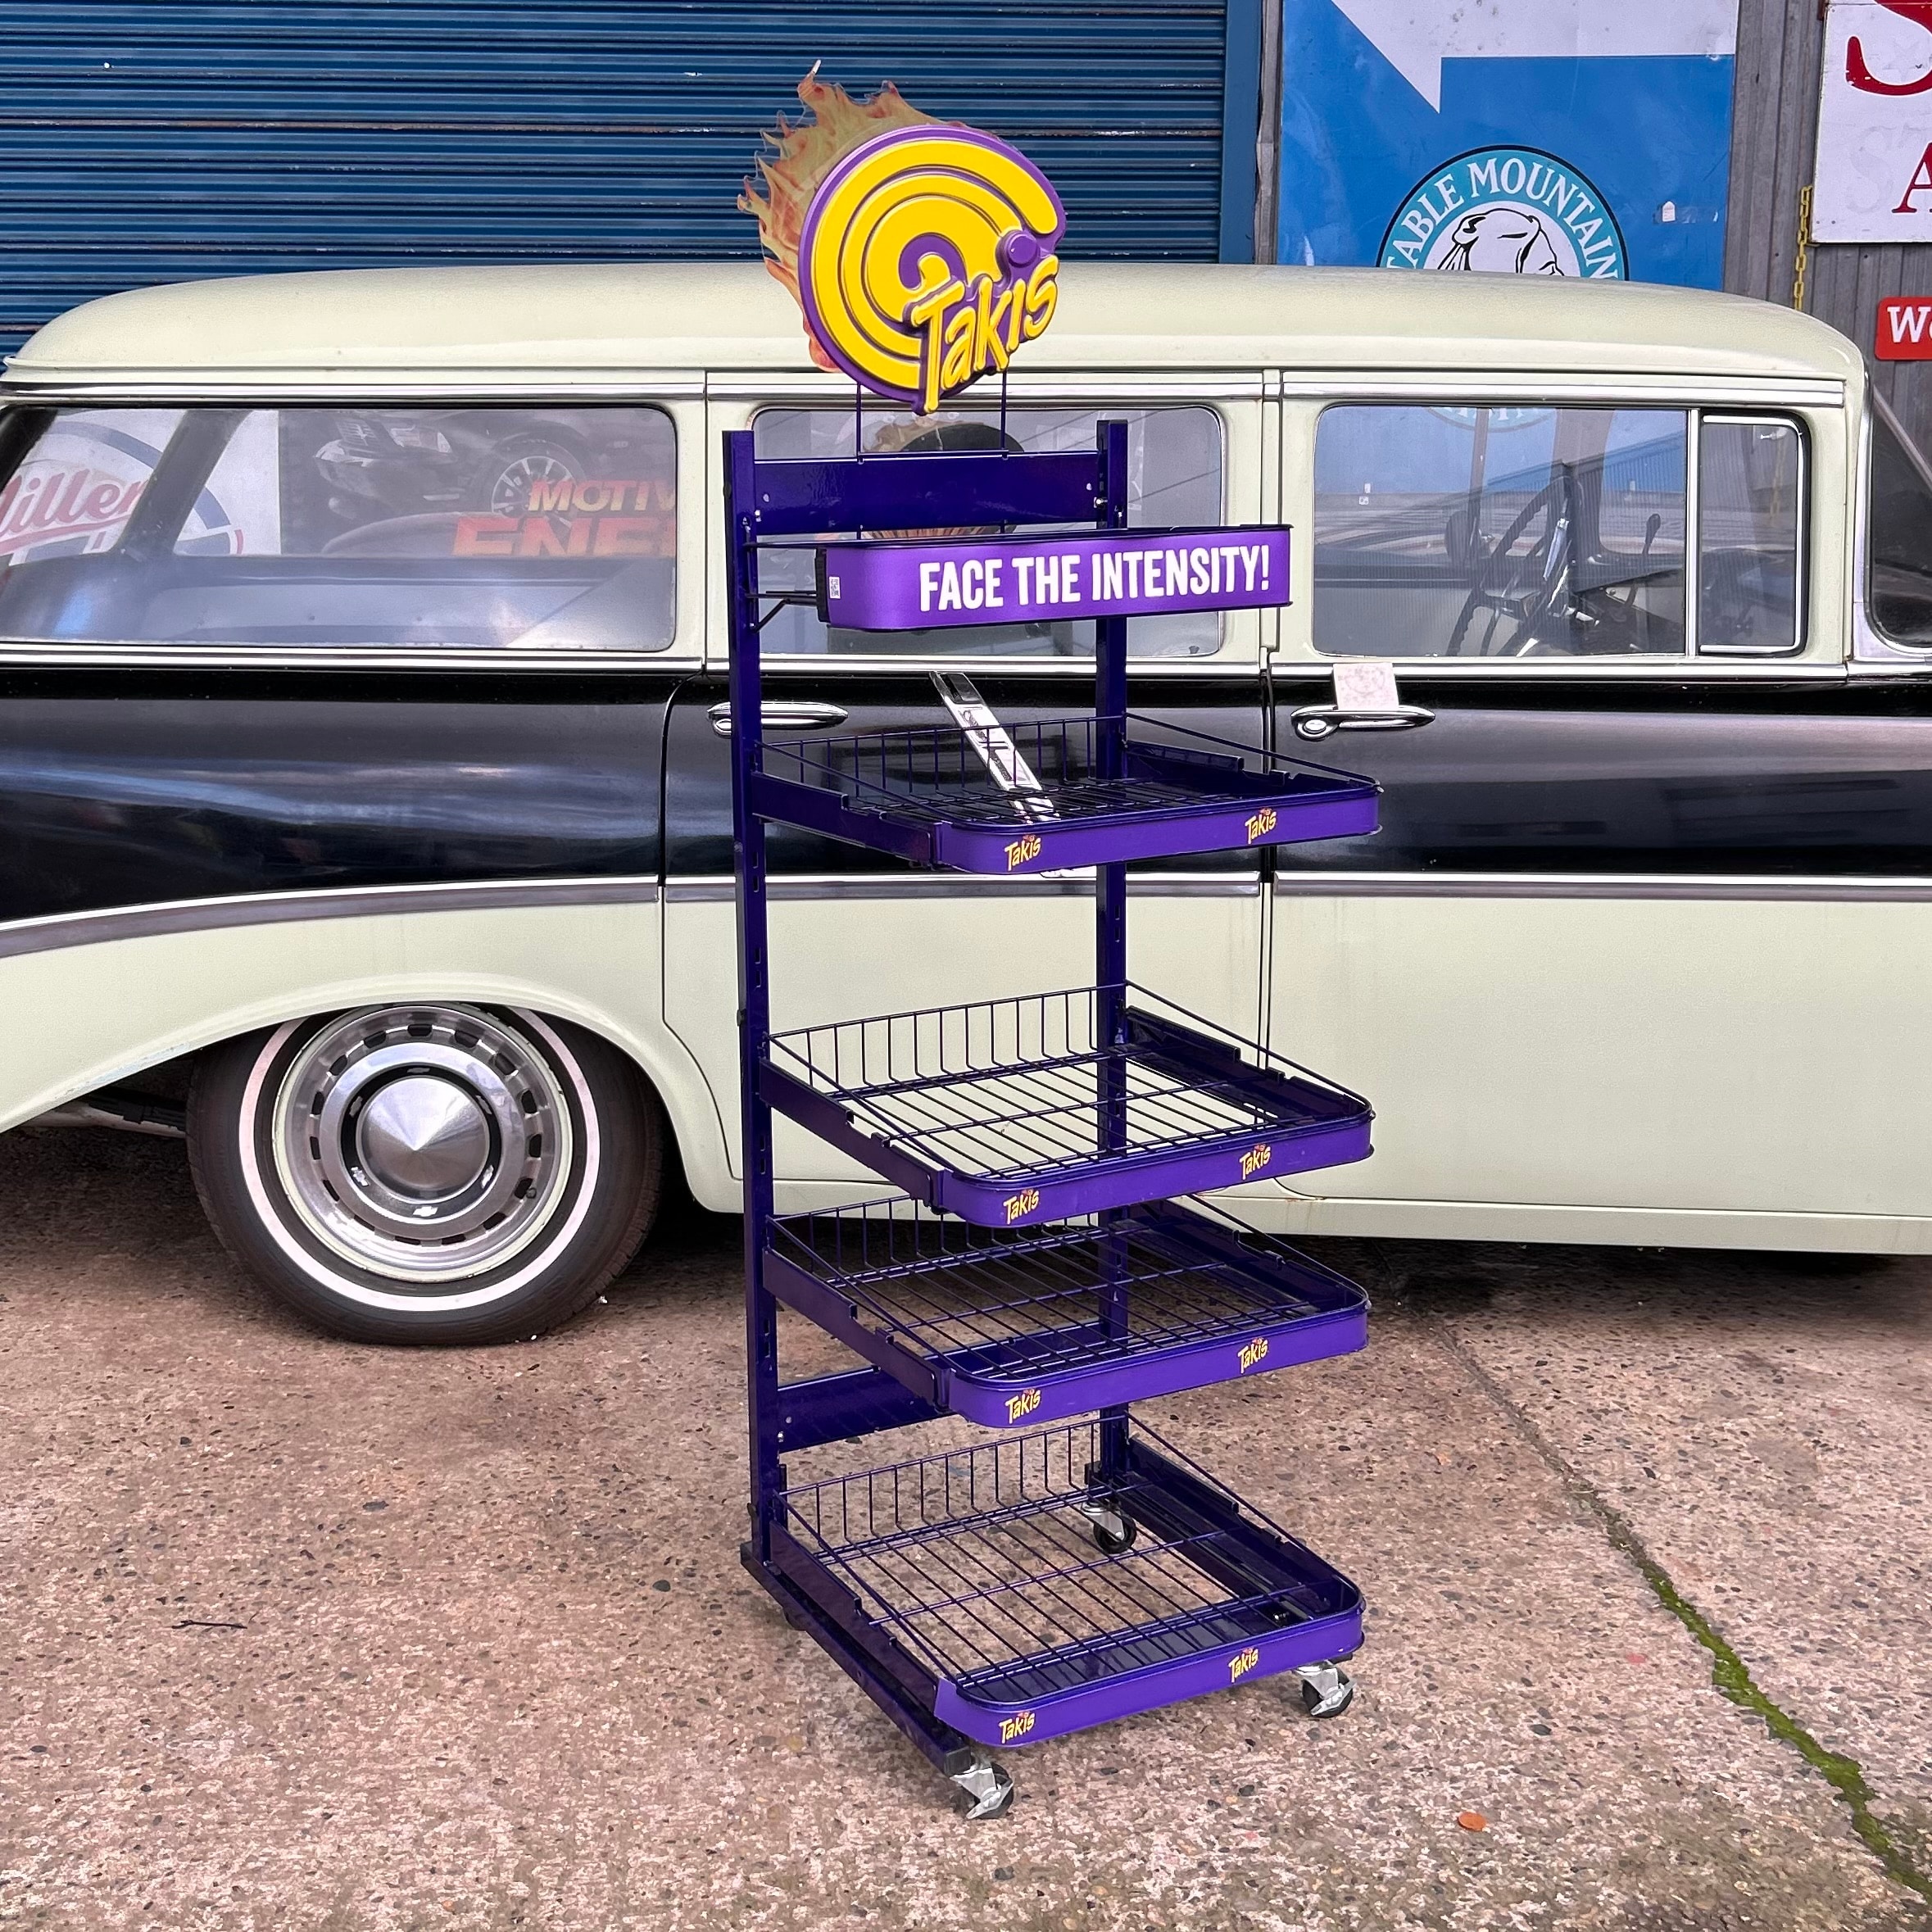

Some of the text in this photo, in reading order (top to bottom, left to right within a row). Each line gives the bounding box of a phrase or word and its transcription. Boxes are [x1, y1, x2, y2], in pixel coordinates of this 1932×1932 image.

[1467, 157, 1619, 279] MOUNTAIN
[910, 255, 1059, 414] Takis
[1887, 306, 1932, 343] W
[453, 516, 678, 557] ENE
[919, 545, 1270, 612] FACE THE INTENSITY!
[1245, 810, 1277, 844] Takis
[1004, 836, 1041, 871] Takis
[1239, 1145, 1271, 1181] Takis
[1003, 1190, 1040, 1225] Takis
[1237, 1339, 1268, 1374] Takis
[1005, 1390, 1041, 1424] Takis
[1228, 1648, 1259, 1683] Takis
[998, 1712, 1035, 1744] Takis
